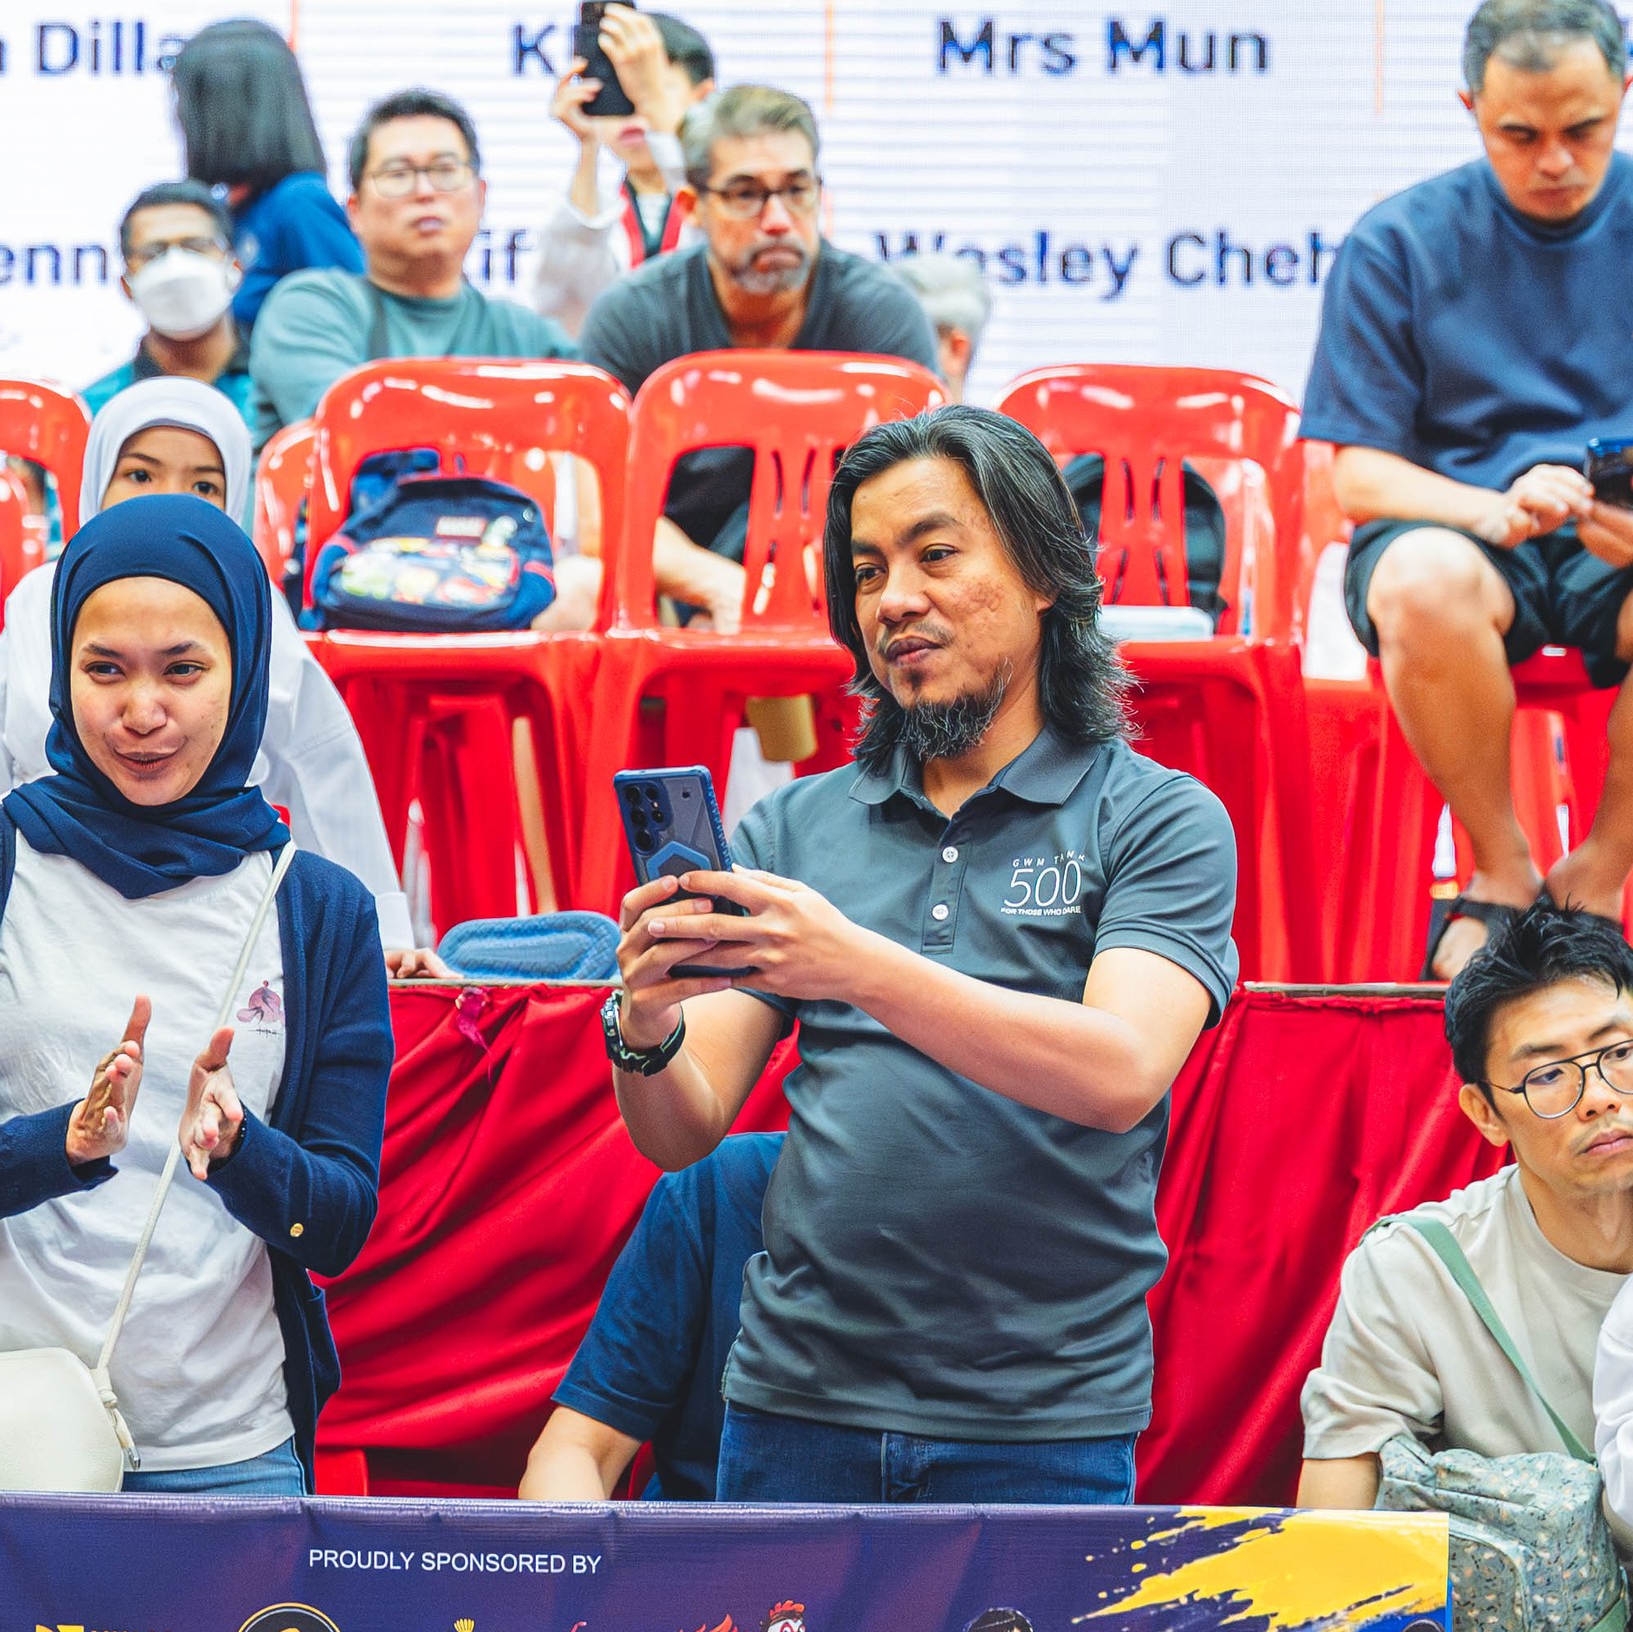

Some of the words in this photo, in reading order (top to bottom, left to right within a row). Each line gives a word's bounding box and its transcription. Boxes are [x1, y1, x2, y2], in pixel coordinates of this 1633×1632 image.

[936, 17, 1077, 74] Mrs
[1106, 17, 1270, 74] Mun
[1003, 860, 1081, 907] 500
[1018, 908, 1042, 916] THOSE
[309, 1549, 415, 1574] PROUDLY
[421, 1550, 565, 1574] SPONSORED
[572, 1553, 602, 1574] BY
